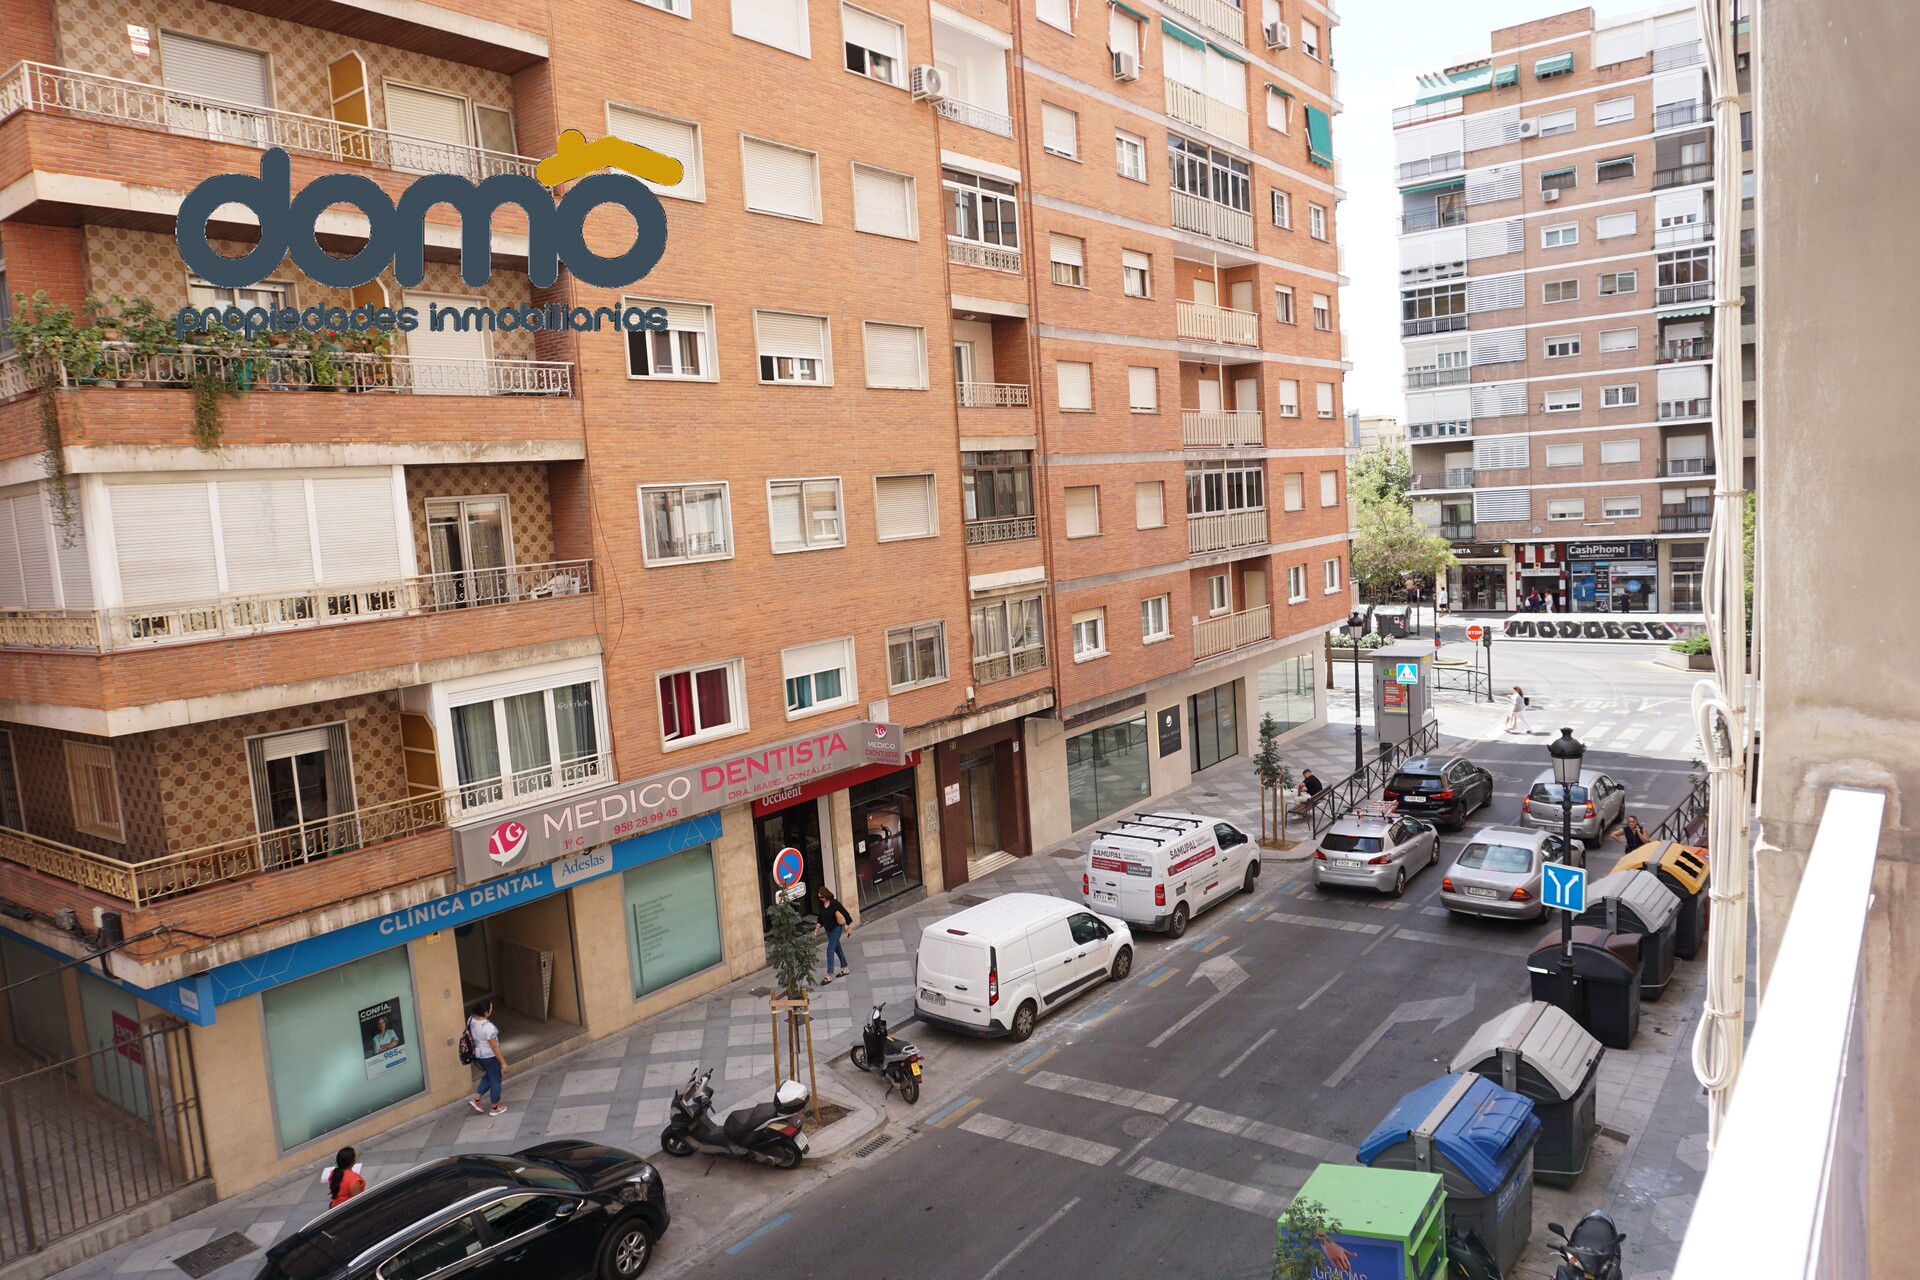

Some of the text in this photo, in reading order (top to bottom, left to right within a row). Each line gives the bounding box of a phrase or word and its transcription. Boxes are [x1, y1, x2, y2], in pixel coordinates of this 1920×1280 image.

[1569, 545, 1626, 555] CashPhone
[864, 749, 900, 758] DENTISTA
[867, 741, 896, 750] MEDICO
[542, 732, 849, 840] MEDICO DENTISTA
[728, 790, 752, 800] DRA.
[753, 778, 784, 792] ISABEL
[761, 785, 803, 807] Occident
[613, 807, 678, 834] 958 28 99 45
[575, 836, 585, 846] C
[1169, 840, 1197, 860] SAMUPAL
[1093, 849, 1122, 859] SAMUPAL
[561, 853, 605, 877] Adeslas
[379, 872, 543, 935] CLÍNICA DENTAL
[360, 1003, 392, 1018] CONFÍA.
